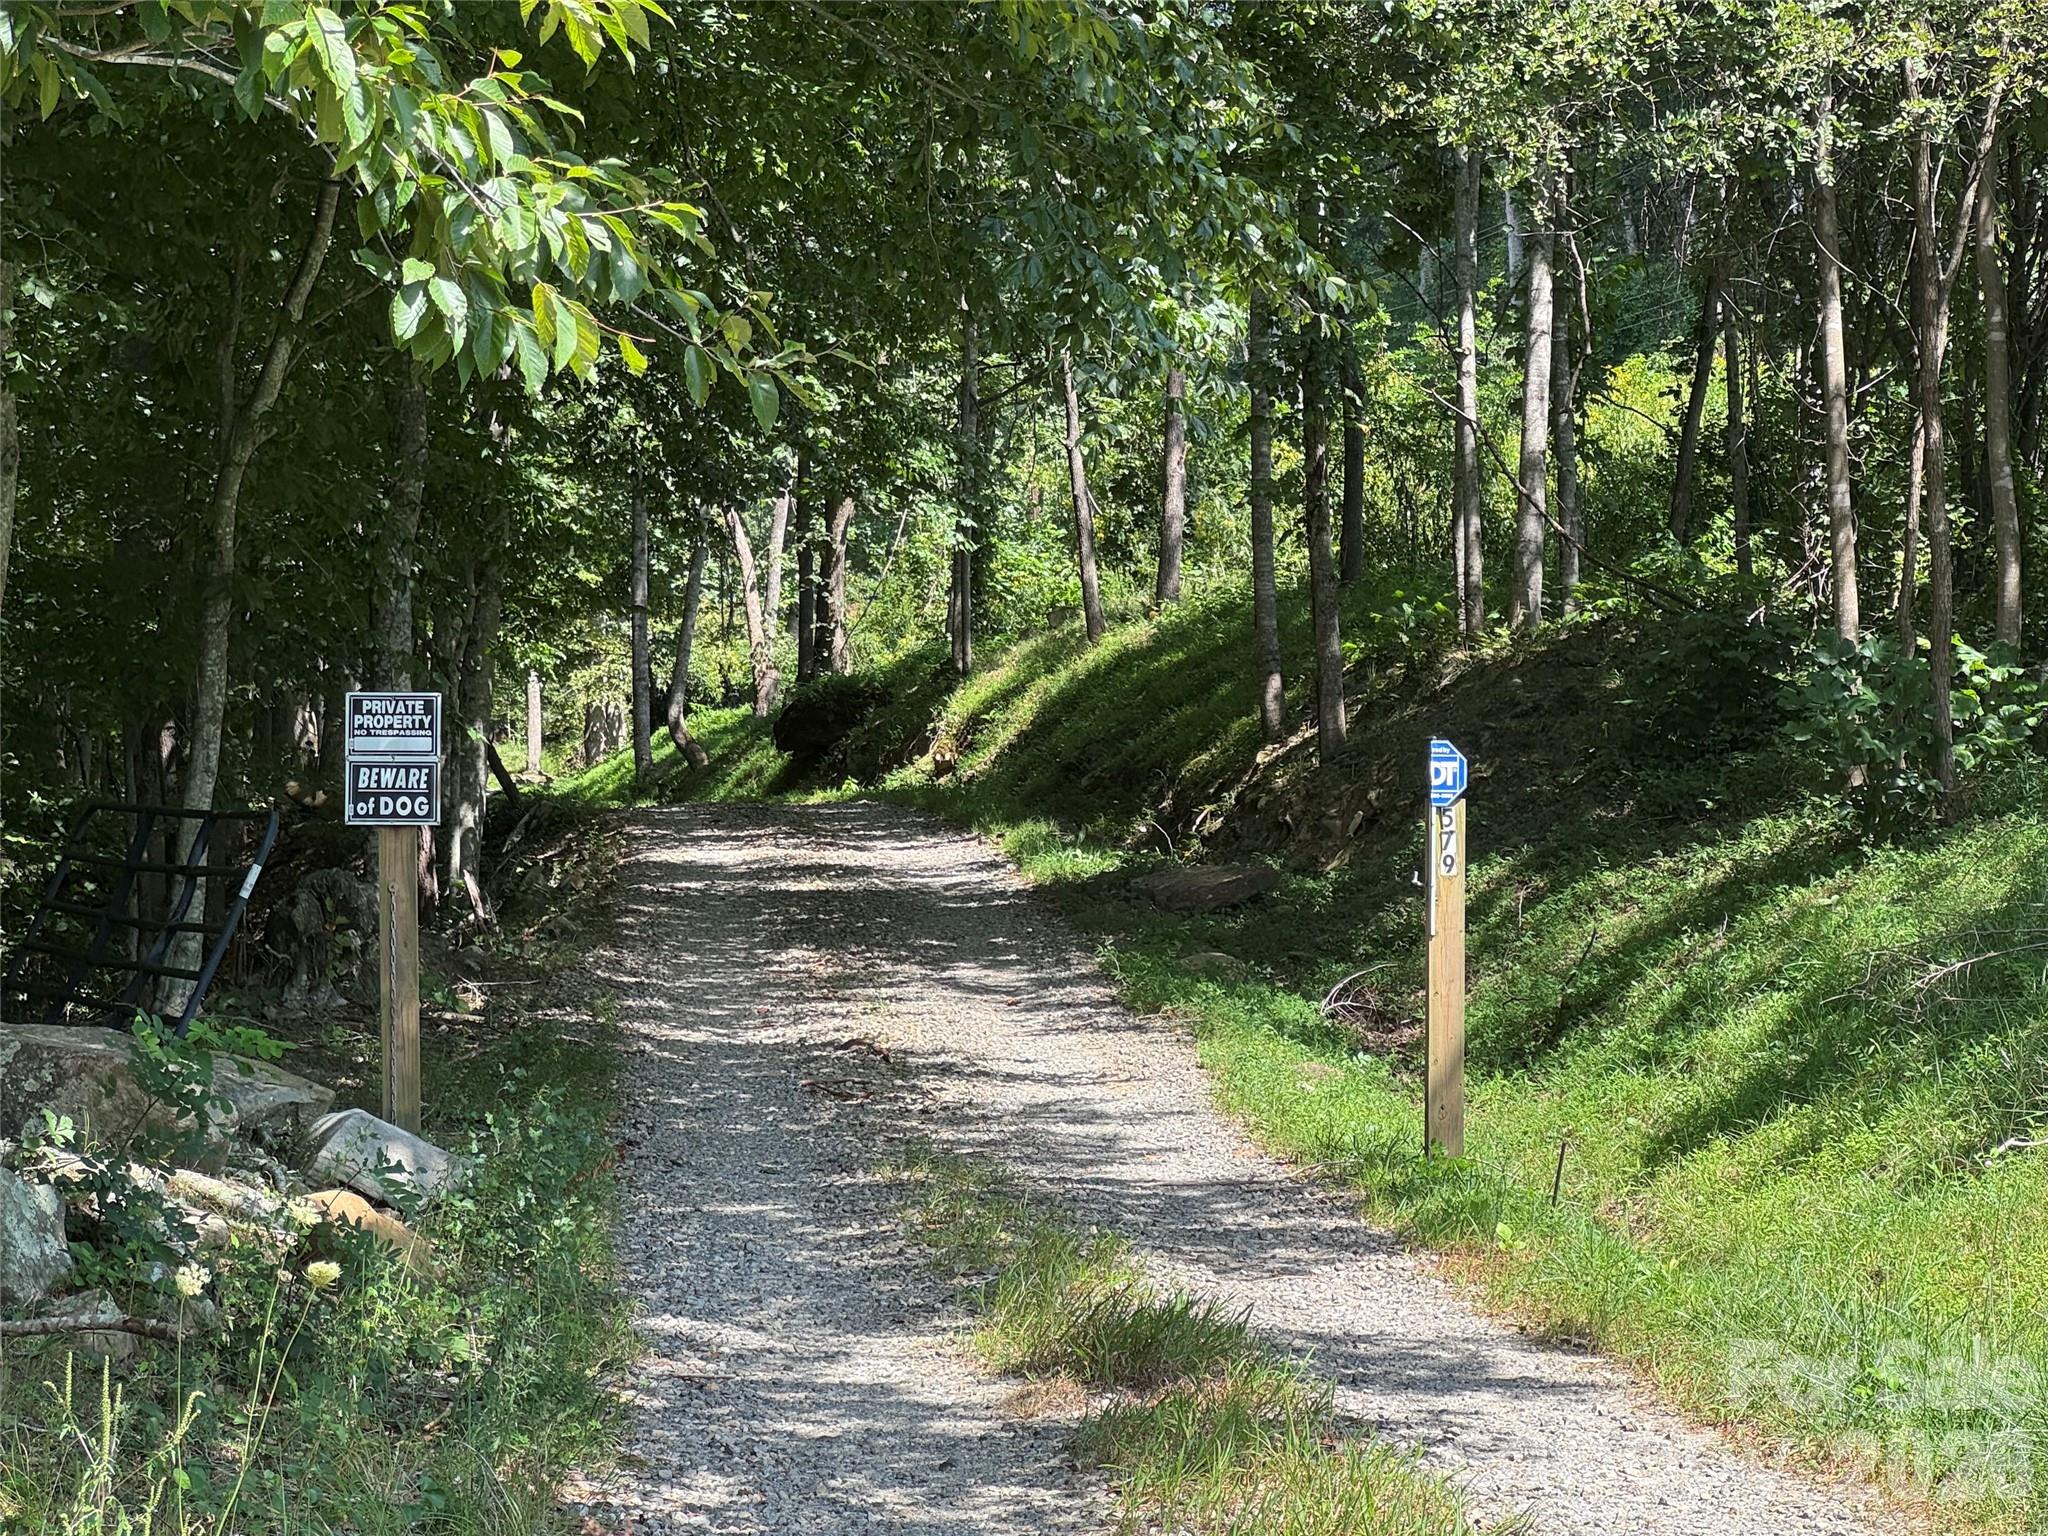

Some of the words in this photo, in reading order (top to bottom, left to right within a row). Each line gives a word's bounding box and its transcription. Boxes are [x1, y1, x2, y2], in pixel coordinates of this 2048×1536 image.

[362, 700, 425, 714] PRIVATE
[354, 715, 432, 729] PROPERTY
[358, 767, 429, 789] BEWARE
[356, 797, 375, 816] of
[379, 796, 430, 816] DOG
